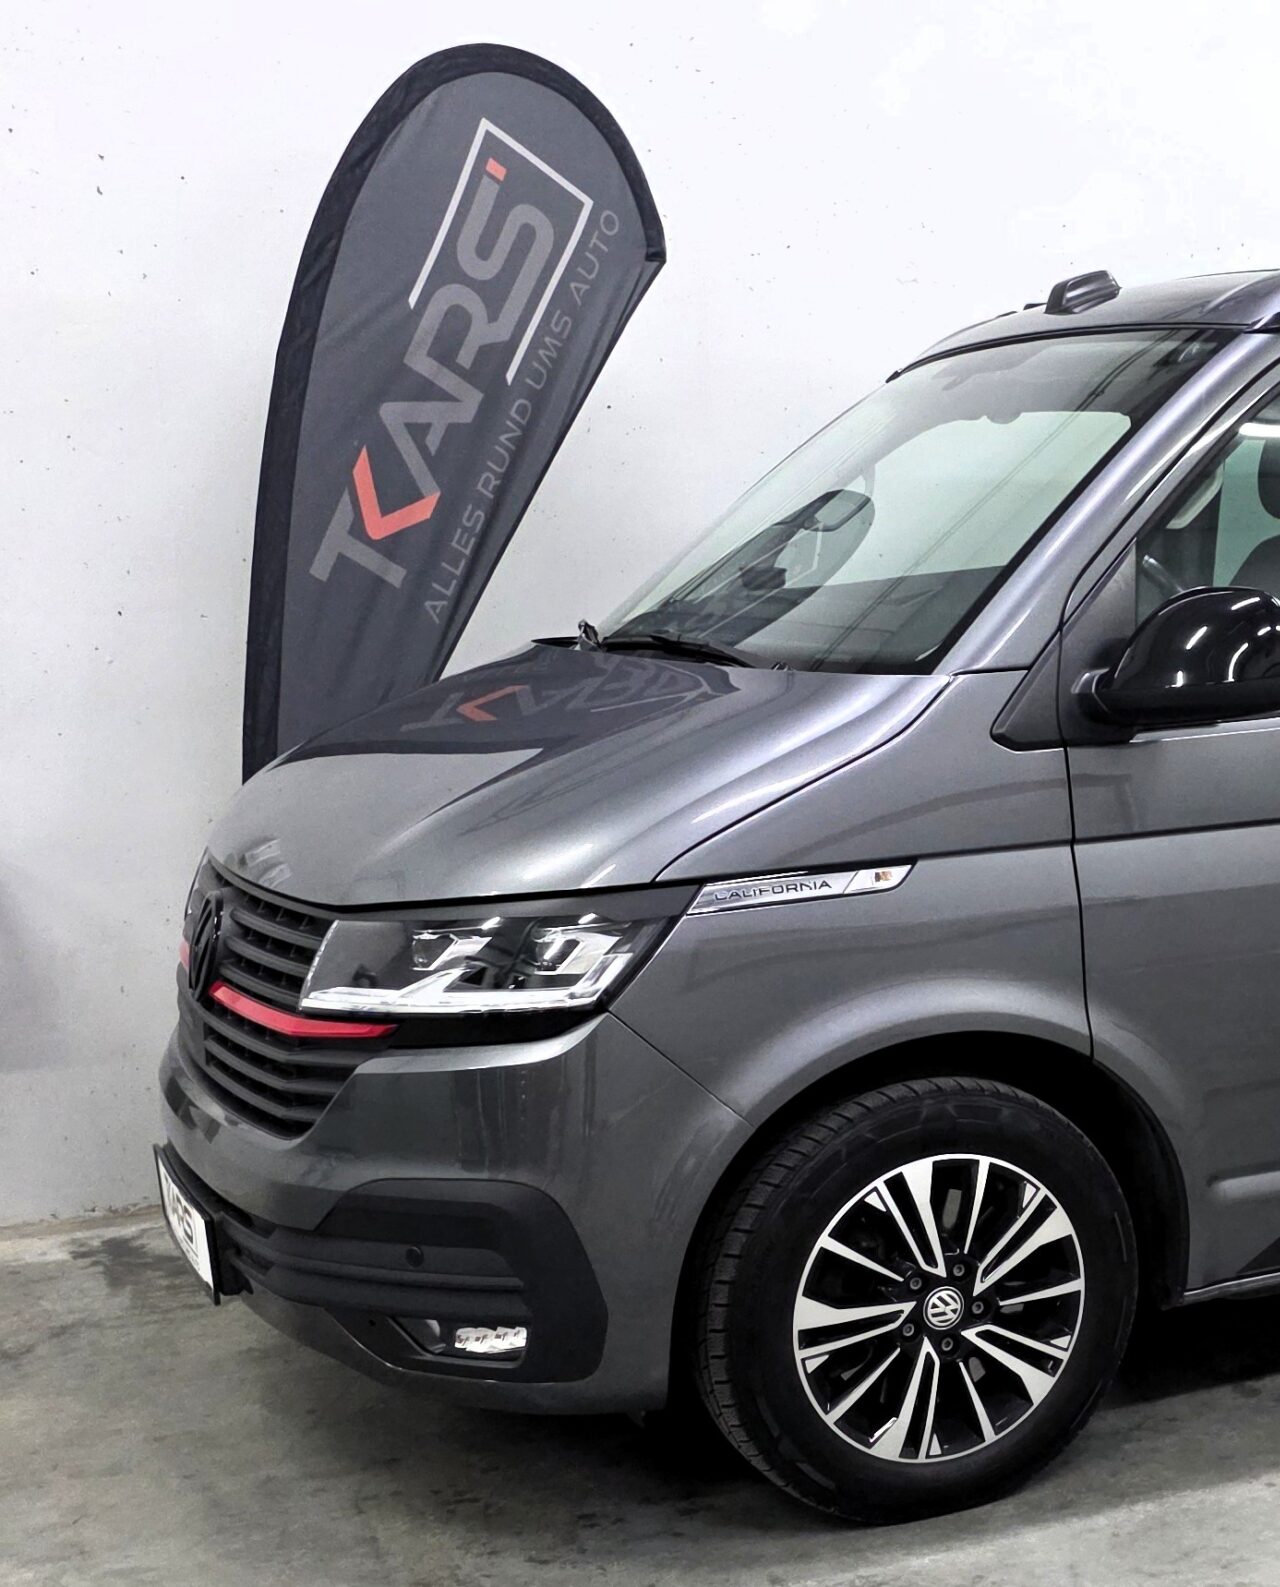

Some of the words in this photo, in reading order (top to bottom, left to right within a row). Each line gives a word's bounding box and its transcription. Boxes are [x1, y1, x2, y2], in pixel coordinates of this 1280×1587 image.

[424, 504, 486, 624] ALLES
[476, 398, 532, 499] RUND
[525, 310, 572, 390] UMS
[569, 210, 620, 306] AUTO
[714, 879, 833, 901] CALIFORNIA
